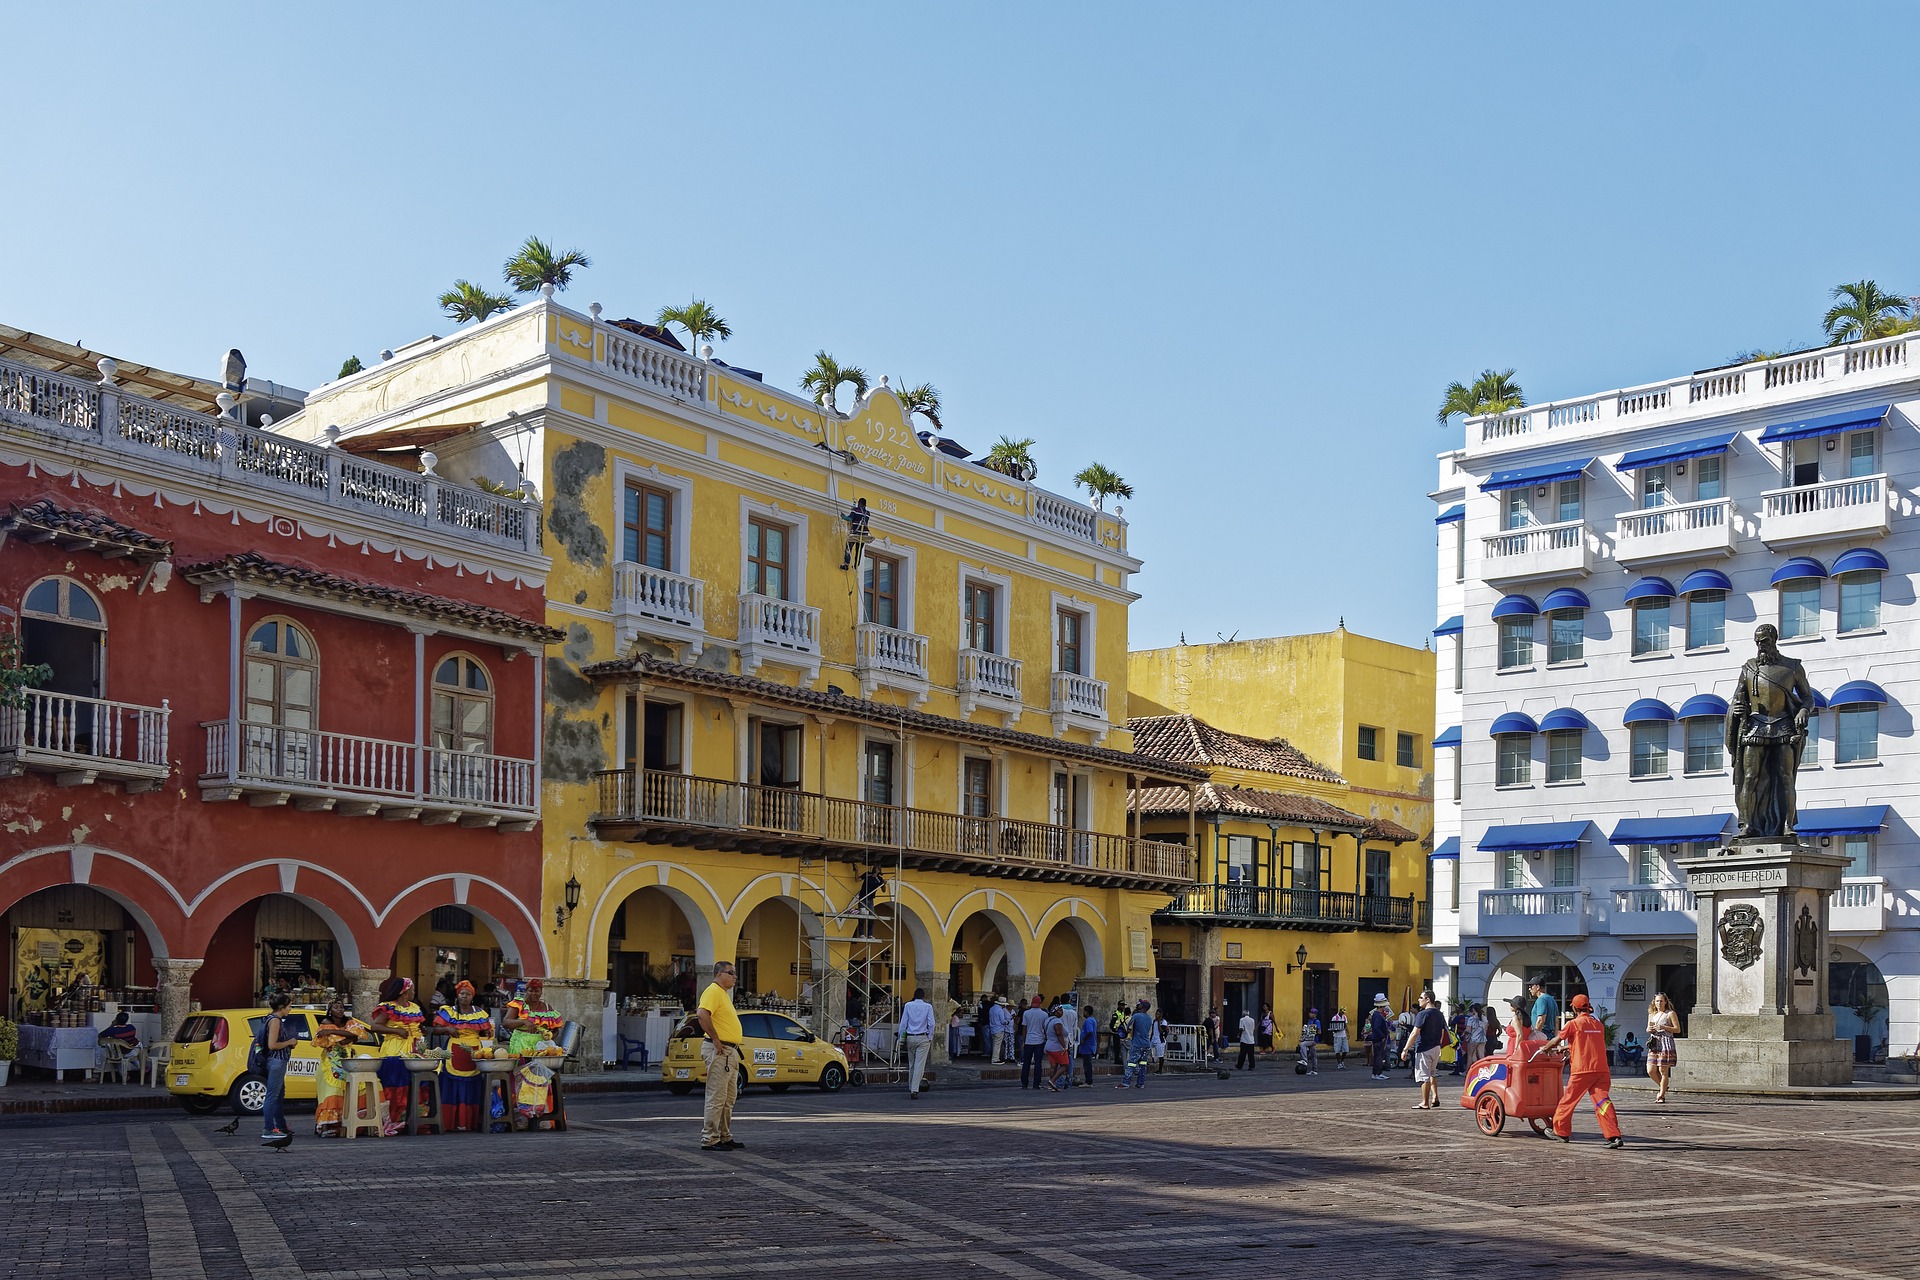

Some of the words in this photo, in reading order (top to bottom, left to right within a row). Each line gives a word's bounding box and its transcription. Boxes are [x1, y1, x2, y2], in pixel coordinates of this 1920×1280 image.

[866, 418, 911, 448] 1922
[842, 435, 894, 467] Gonzalez
[879, 498, 897, 514] 1988
[1691, 872, 1727, 885] PEDRO
[1737, 870, 1782, 882] HEREDIA
[274, 948, 303, 956] $10.000
